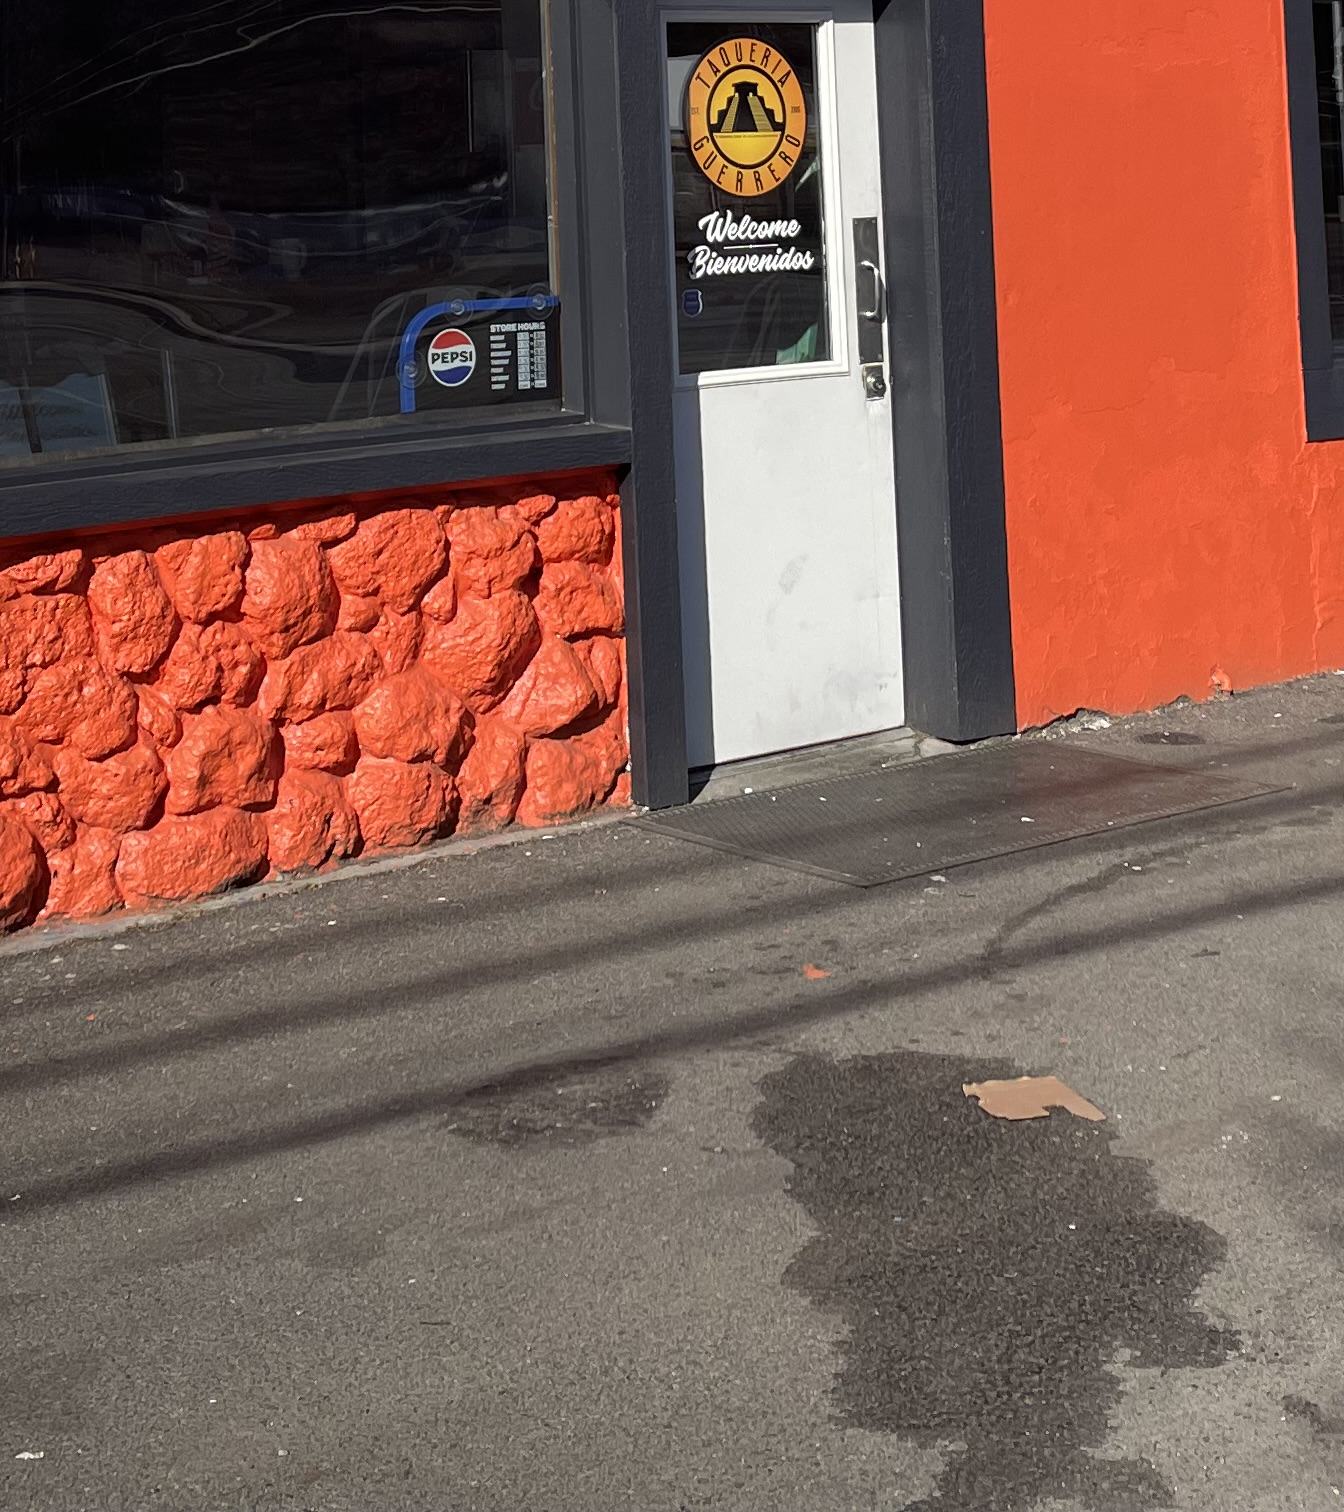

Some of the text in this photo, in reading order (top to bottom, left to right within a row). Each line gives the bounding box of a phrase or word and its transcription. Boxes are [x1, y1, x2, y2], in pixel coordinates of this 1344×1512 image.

[695, 41, 793, 89] TAQUERIA
[693, 134, 801, 193] GUERRERO
[698, 209, 801, 243] Welcome
[687, 245, 814, 280] Bienvenidos
[490, 321, 545, 333] STORE HOURS
[431, 350, 473, 364] PEPSI
